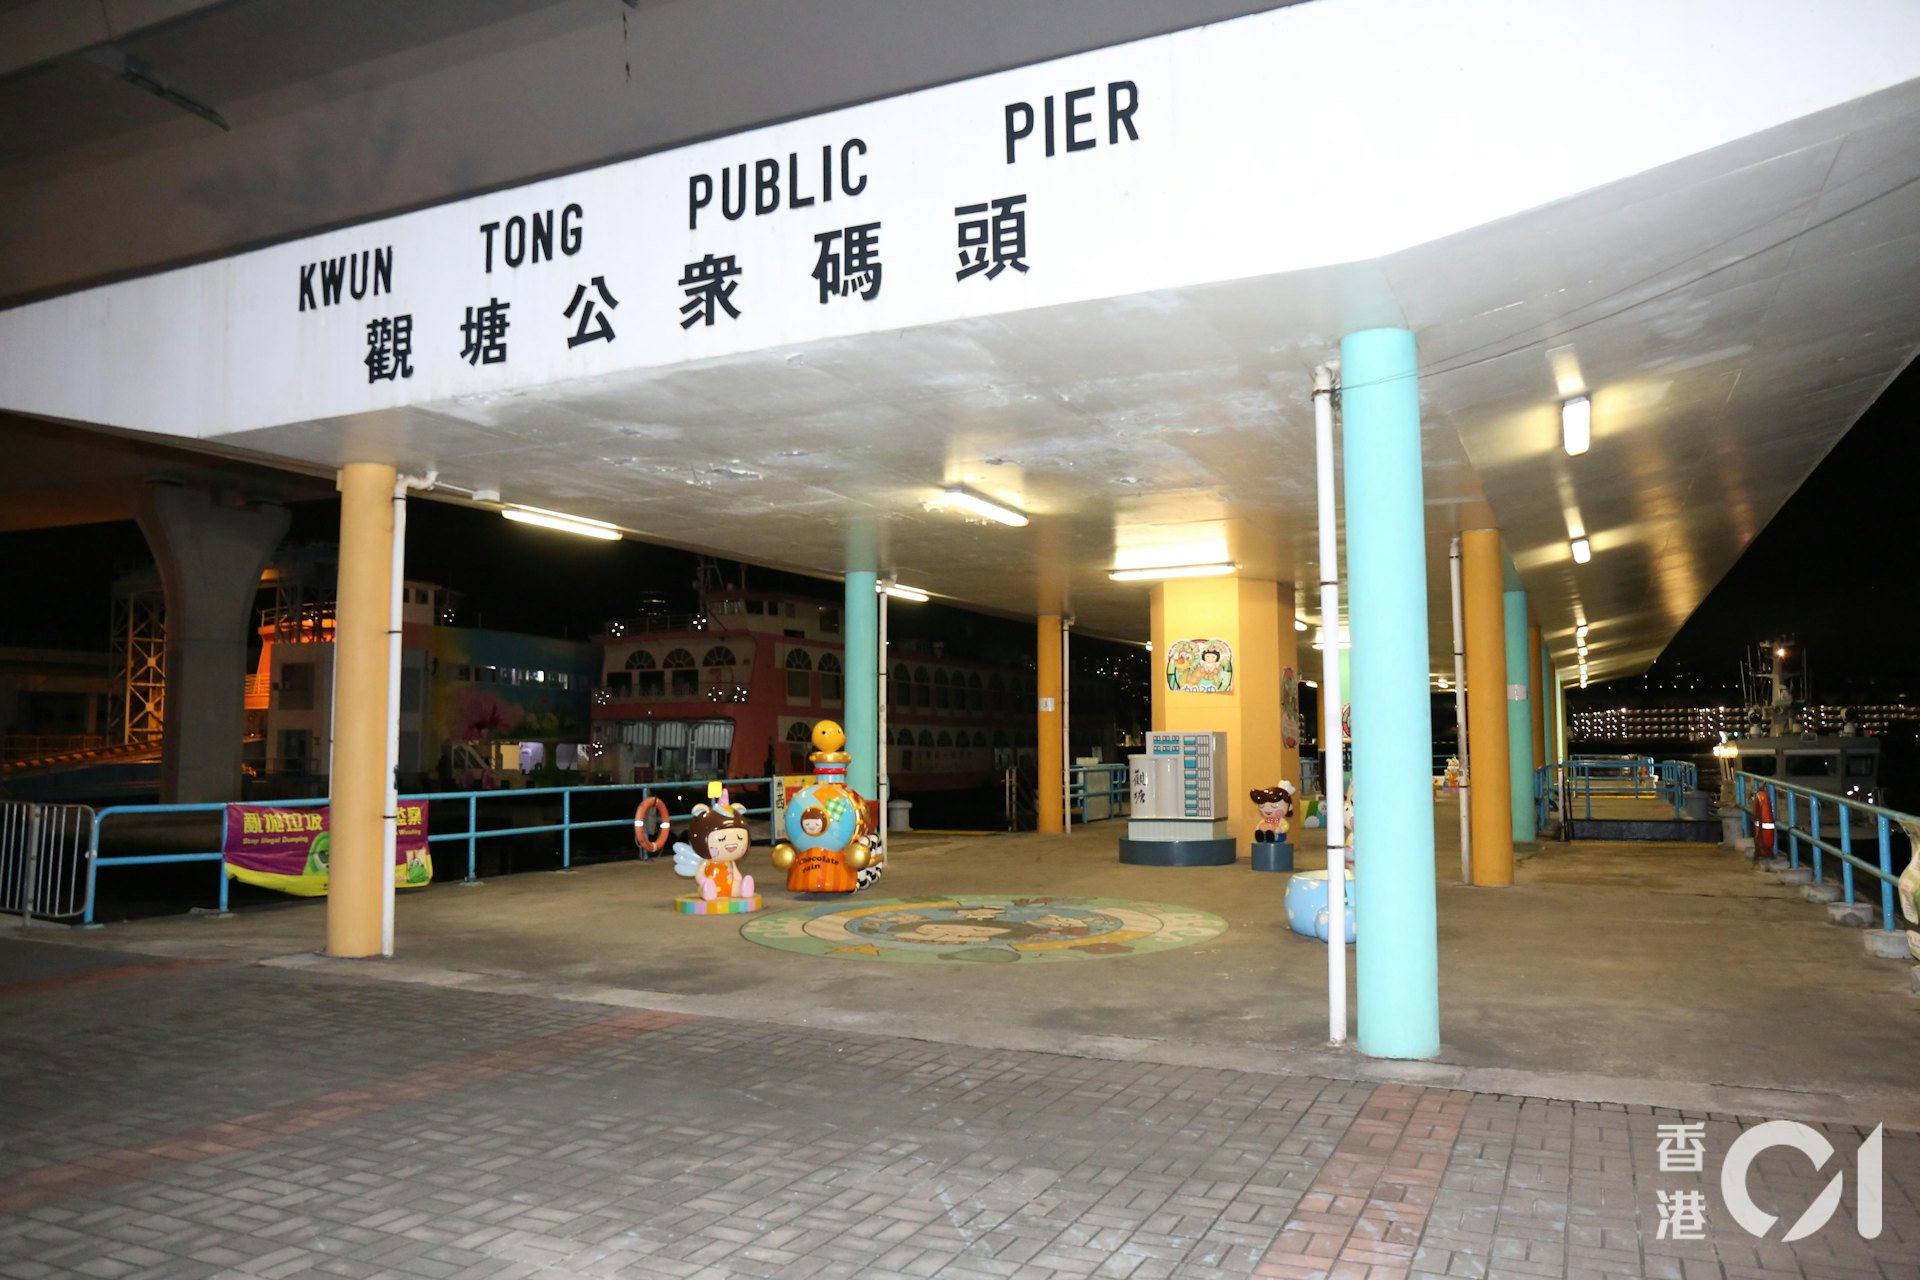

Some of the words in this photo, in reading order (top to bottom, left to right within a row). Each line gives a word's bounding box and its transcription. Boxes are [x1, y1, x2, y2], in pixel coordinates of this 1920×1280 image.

[298, 245, 393, 312] KWUN
[480, 203, 584, 273] TONG
[688, 138, 868, 230] PUBLIC
[1004, 80, 1141, 164] PIER
